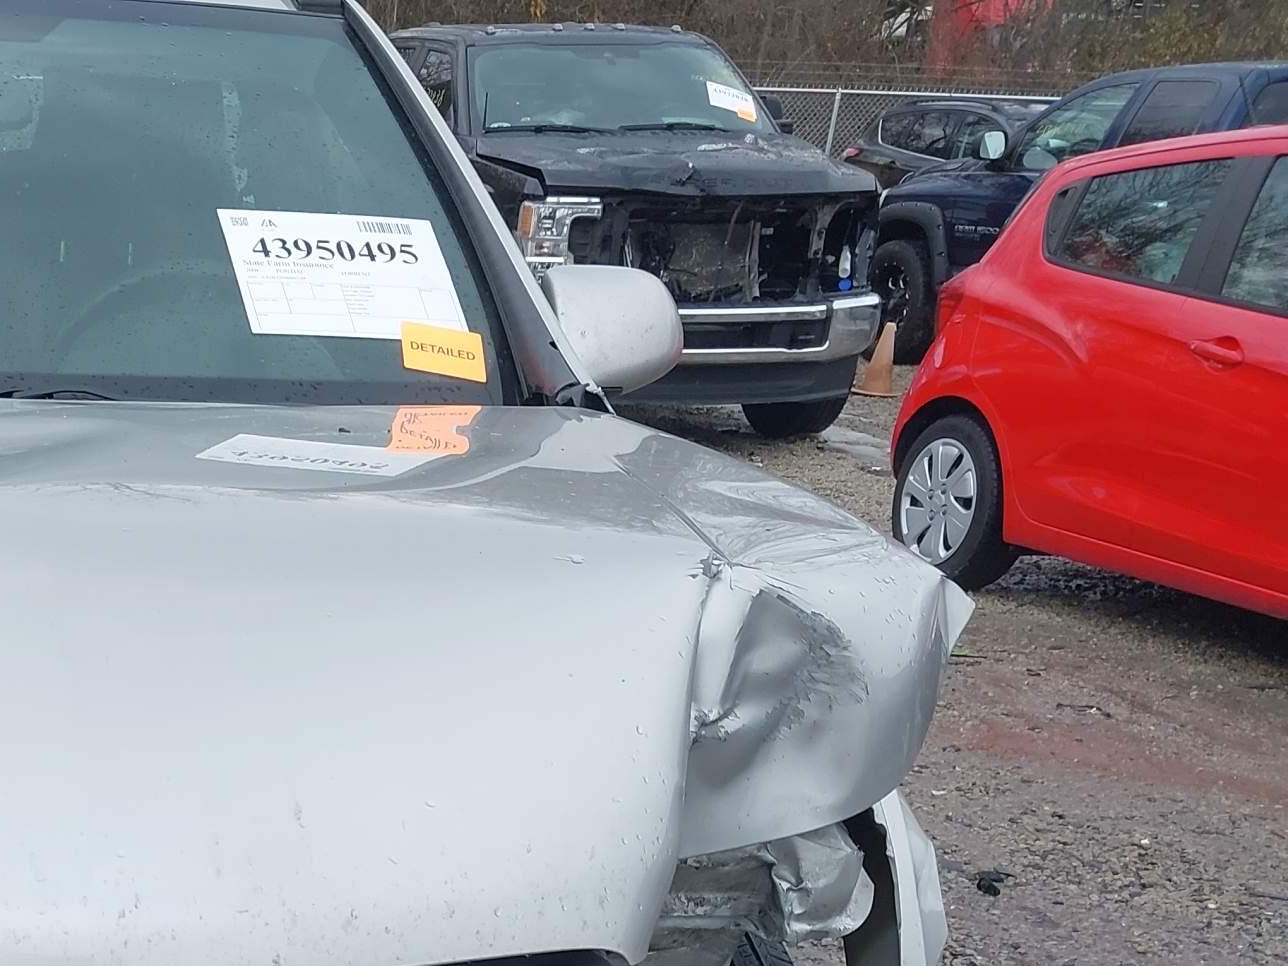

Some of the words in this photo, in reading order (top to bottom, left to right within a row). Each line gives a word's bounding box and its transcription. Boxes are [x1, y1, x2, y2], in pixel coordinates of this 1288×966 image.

[252, 236, 419, 265] 43950495
[243, 259, 265, 267] State
[266, 260, 291, 268] Farm
[410, 340, 476, 361] DETAILED
